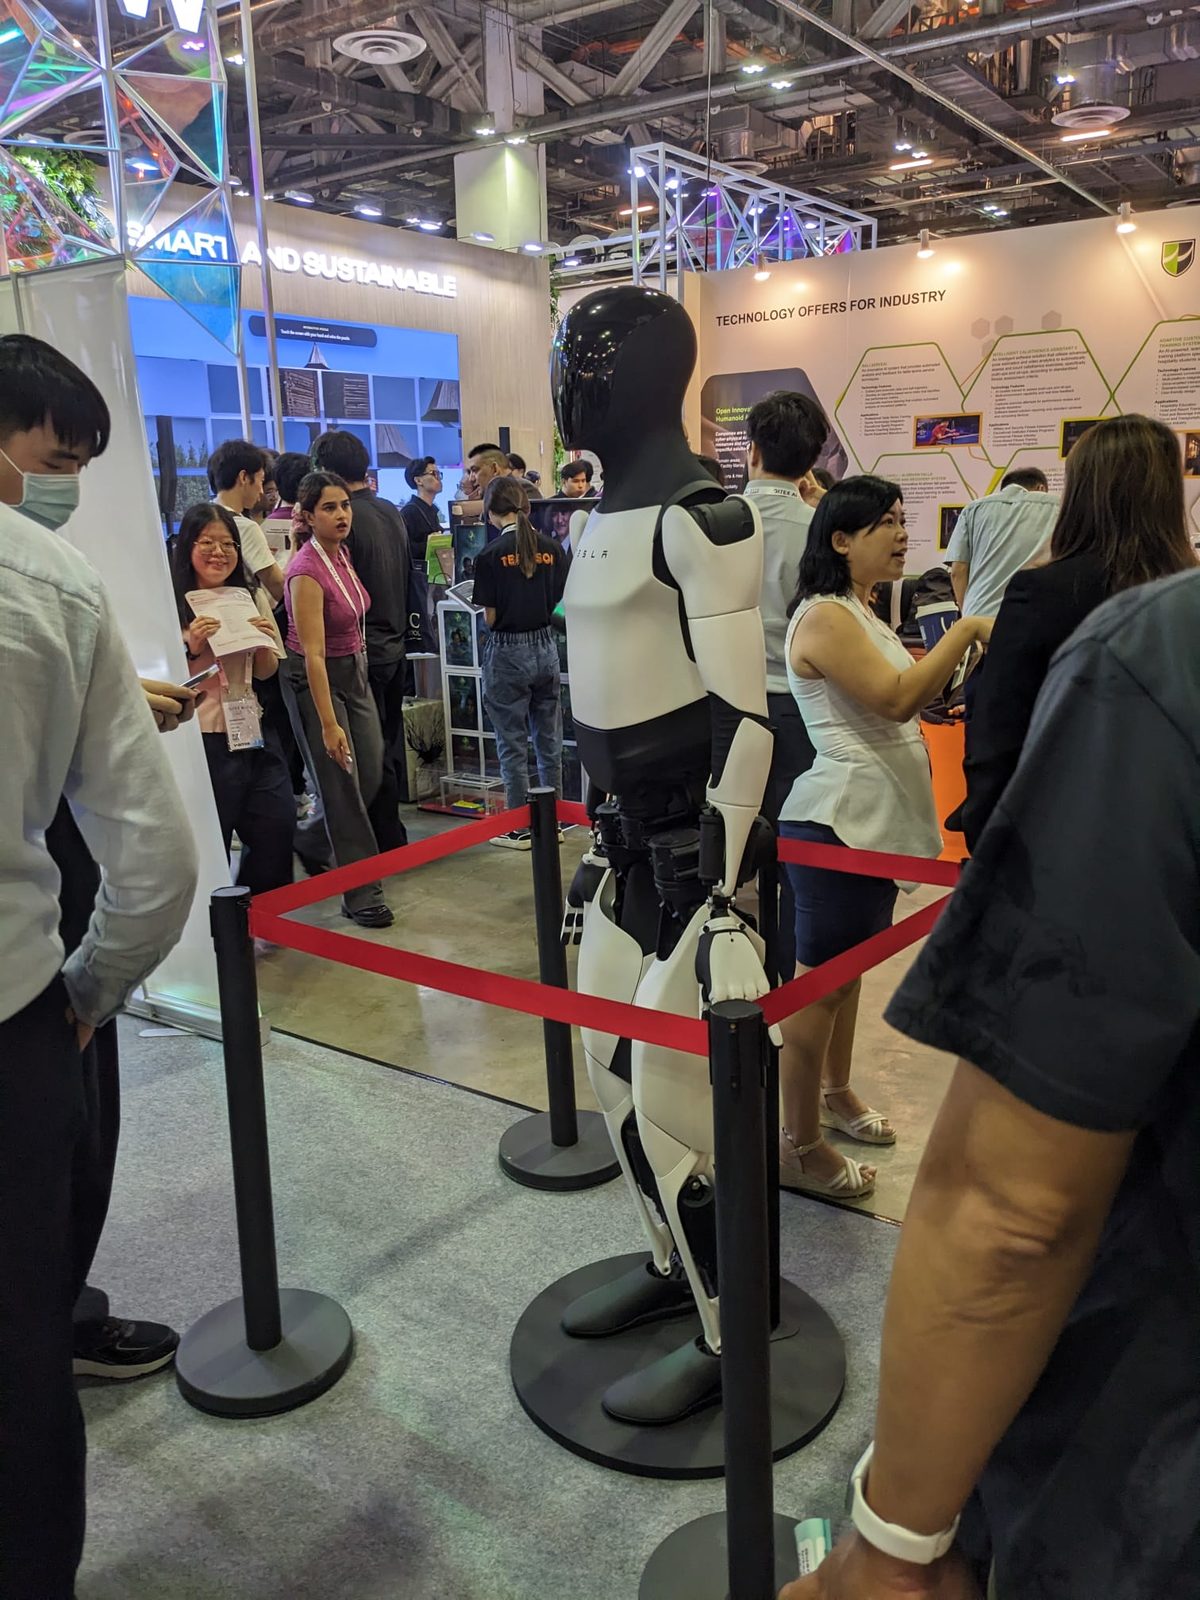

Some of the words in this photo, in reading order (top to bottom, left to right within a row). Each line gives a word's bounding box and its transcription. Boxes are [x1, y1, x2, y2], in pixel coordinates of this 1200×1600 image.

[126, 220, 228, 260] SMART
[241, 241, 300, 272] AND
[302, 251, 457, 298] SUSTAINABLE
[716, 307, 795, 326] TECHNOLOGY
[798, 301, 846, 317] OFFERS
[850, 298, 876, 312] FOR
[880, 290, 946, 308] INDUSTRY
